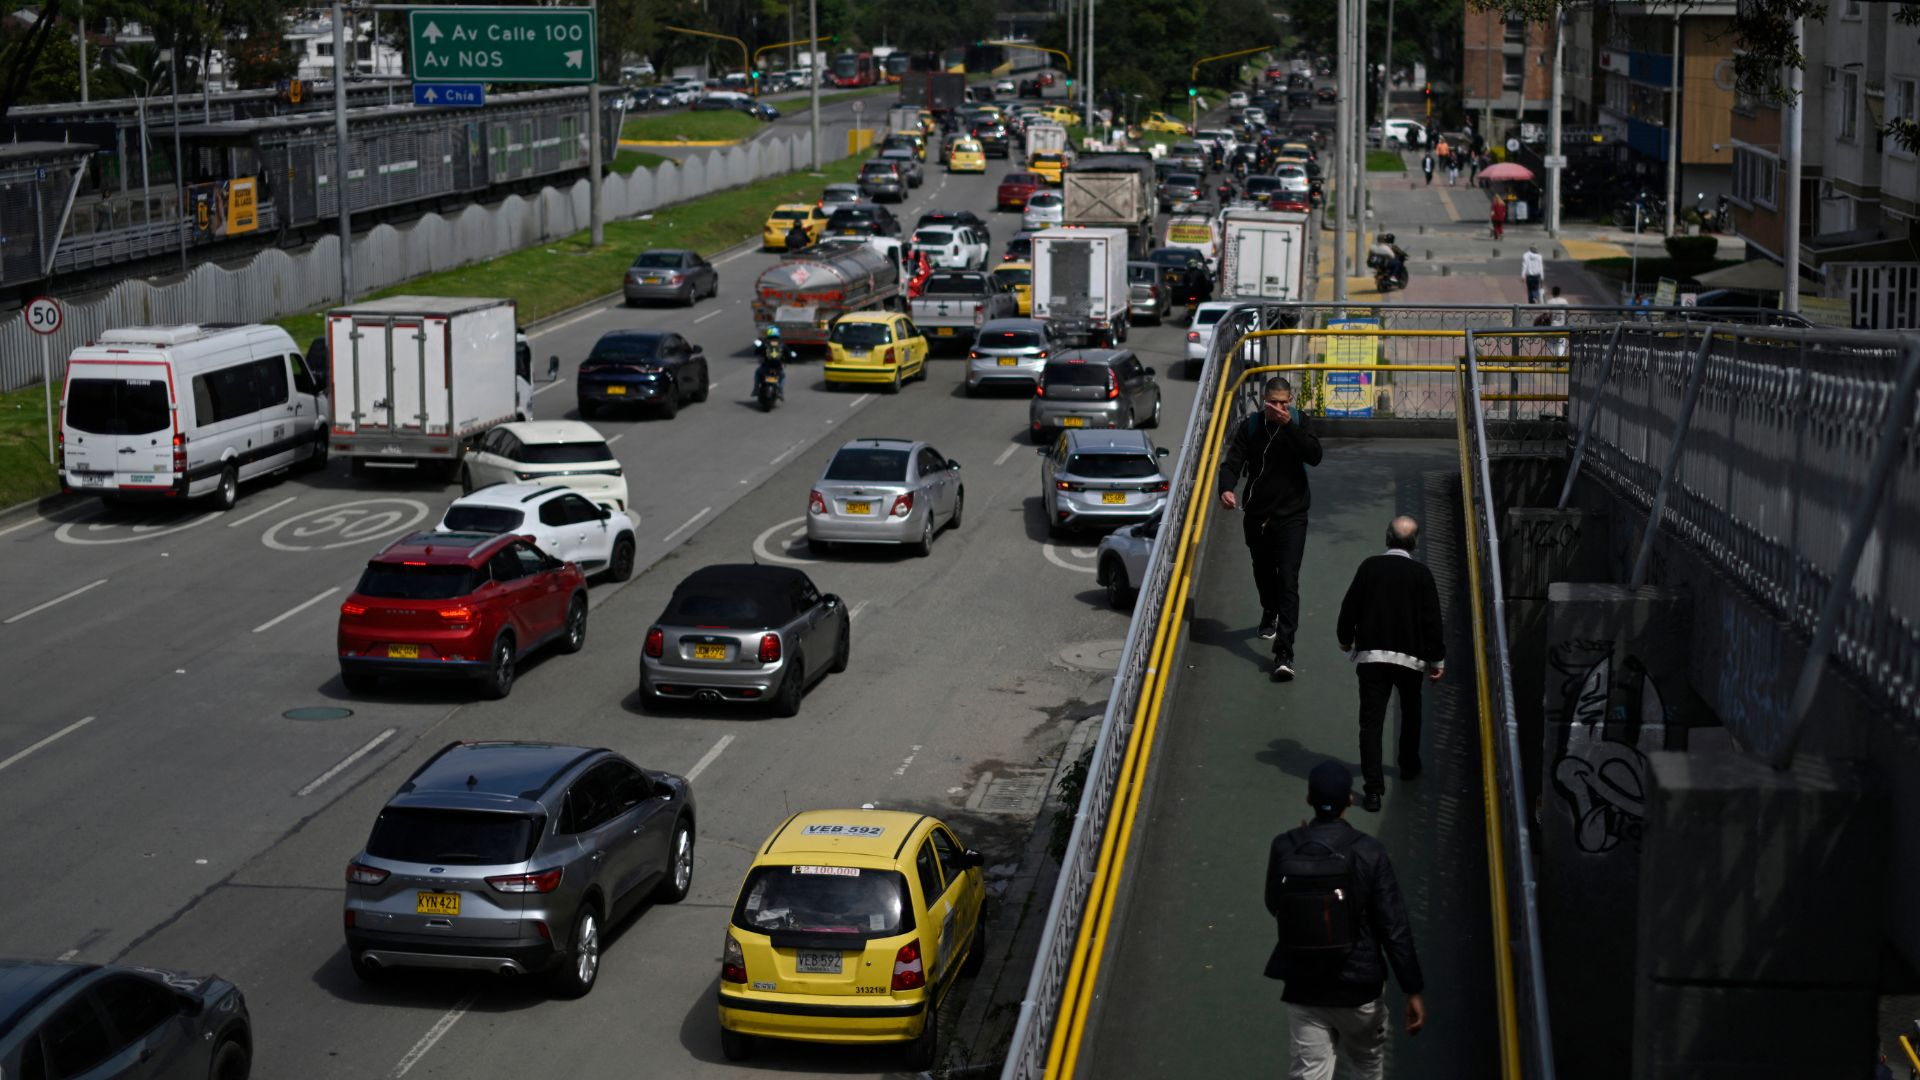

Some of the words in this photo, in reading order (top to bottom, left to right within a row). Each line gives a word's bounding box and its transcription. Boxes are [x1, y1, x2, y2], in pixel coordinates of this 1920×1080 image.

[452, 24, 478, 41] Av
[487, 24, 537, 41] Calle
[545, 24, 583, 41] 100
[423, 51, 450, 68] Av
[458, 51, 503, 68] NQS
[33, 307, 57, 325] 50
[292, 508, 403, 538] 50
[418, 895, 438, 908] KYN
[439, 896, 457, 910] 421
[855, 986, 879, 994] 31321
